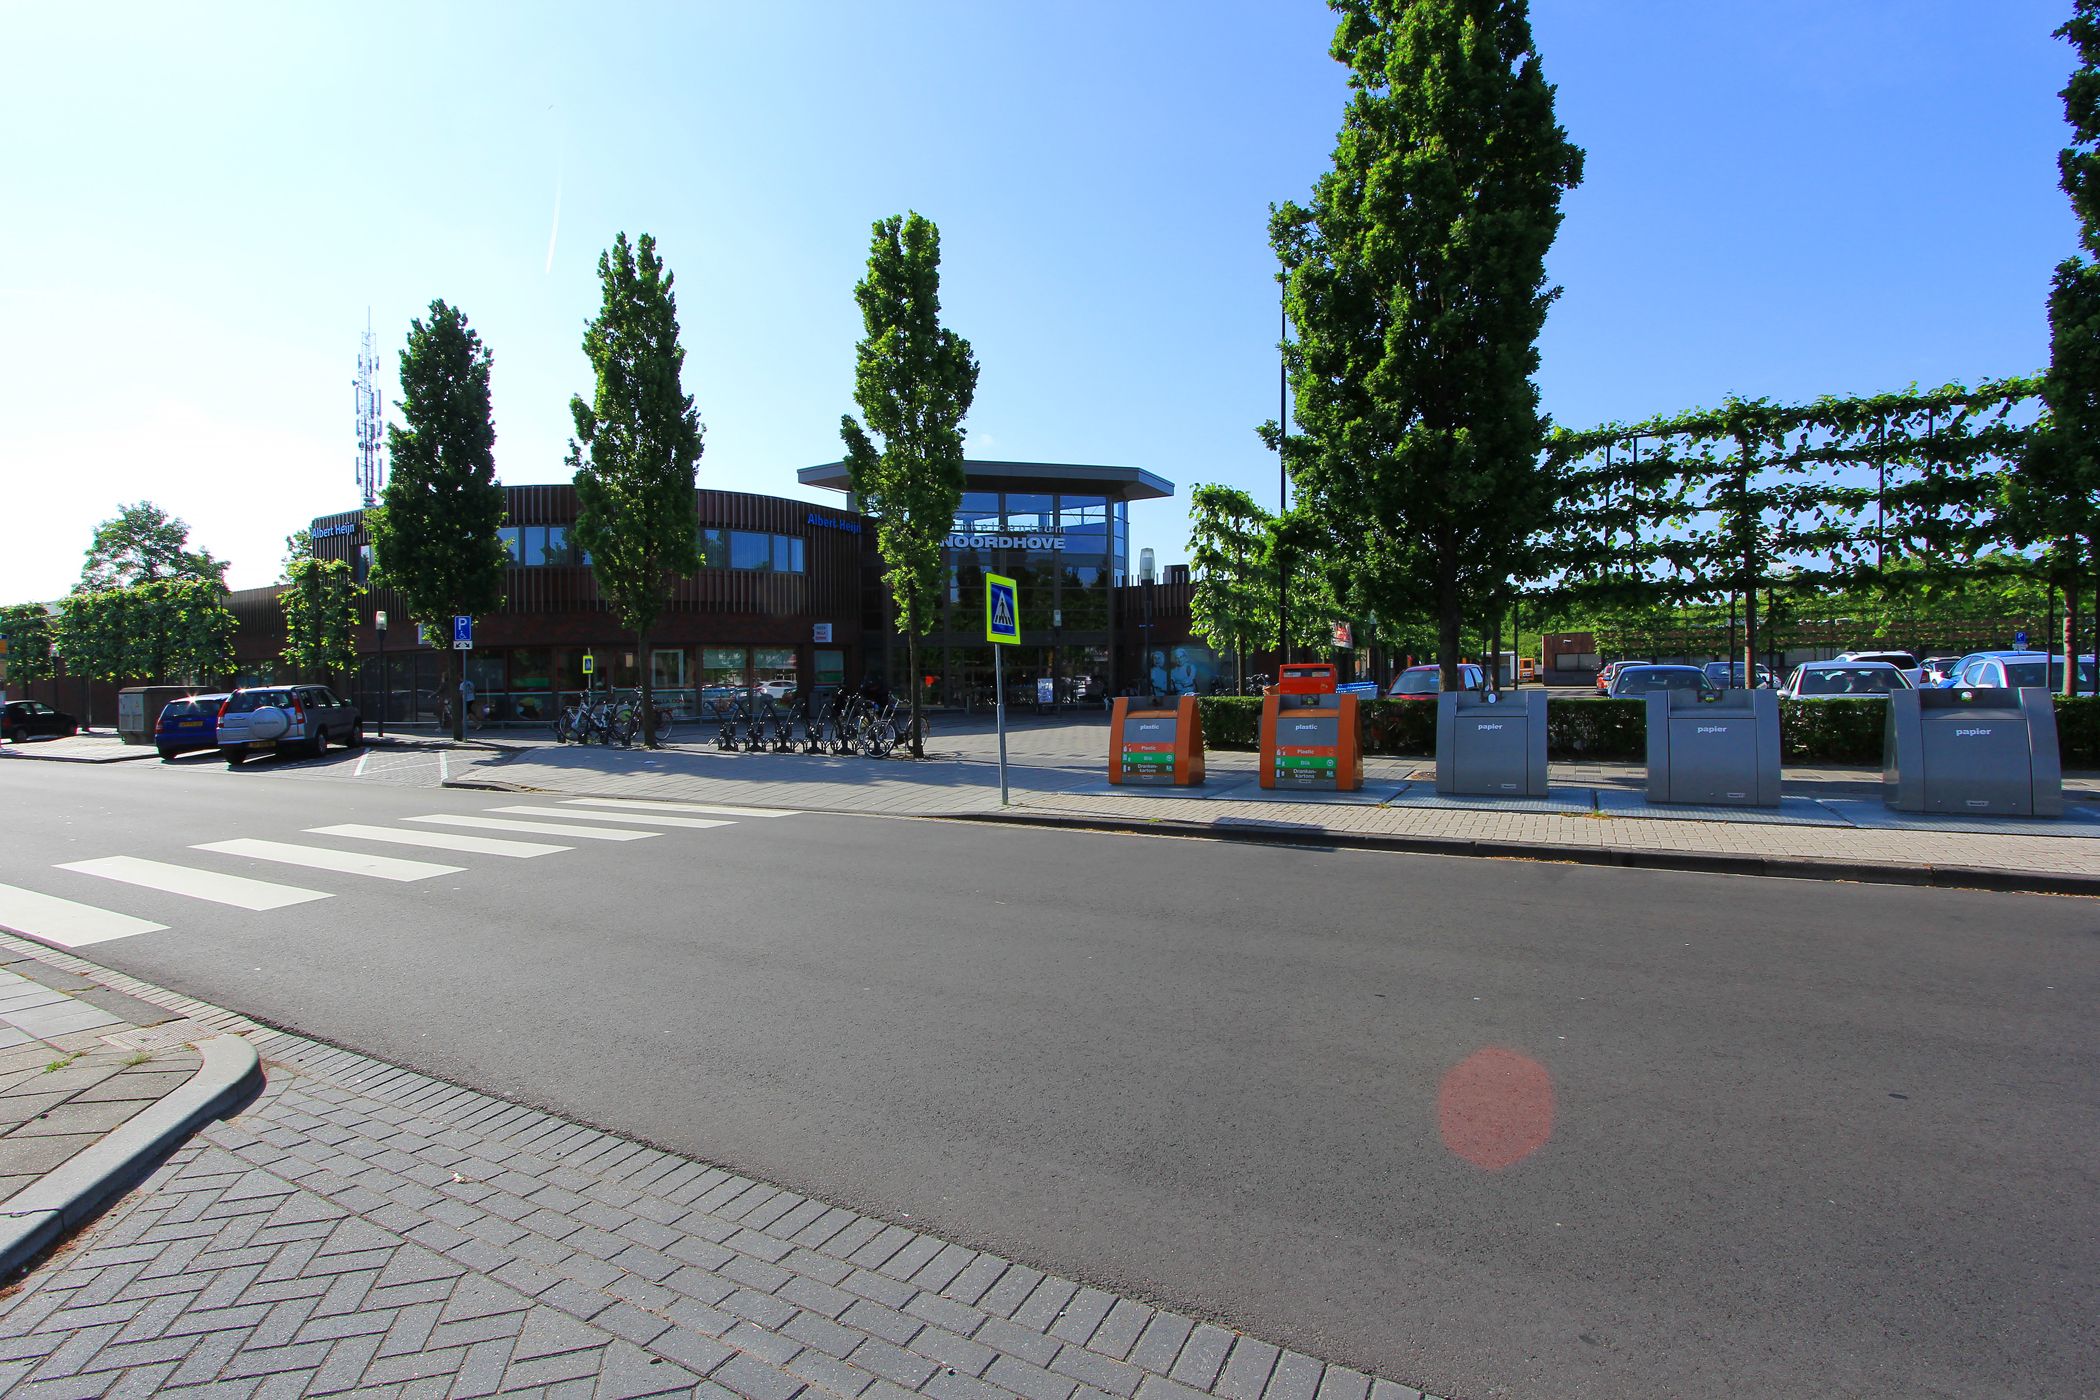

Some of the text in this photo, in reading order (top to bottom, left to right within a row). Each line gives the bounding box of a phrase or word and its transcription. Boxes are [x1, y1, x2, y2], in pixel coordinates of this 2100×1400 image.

[808, 513, 861, 534] Albert Heijn
[951, 521, 1066, 534] inkelcentrum
[312, 522, 355, 538] Albert Heijn
[940, 536, 1066, 549] NOORDHOVE
[458, 618, 468, 630] P
[1478, 723, 1503, 731] papier
[1697, 725, 1728, 734] papier
[1956, 727, 1992, 737] papier
